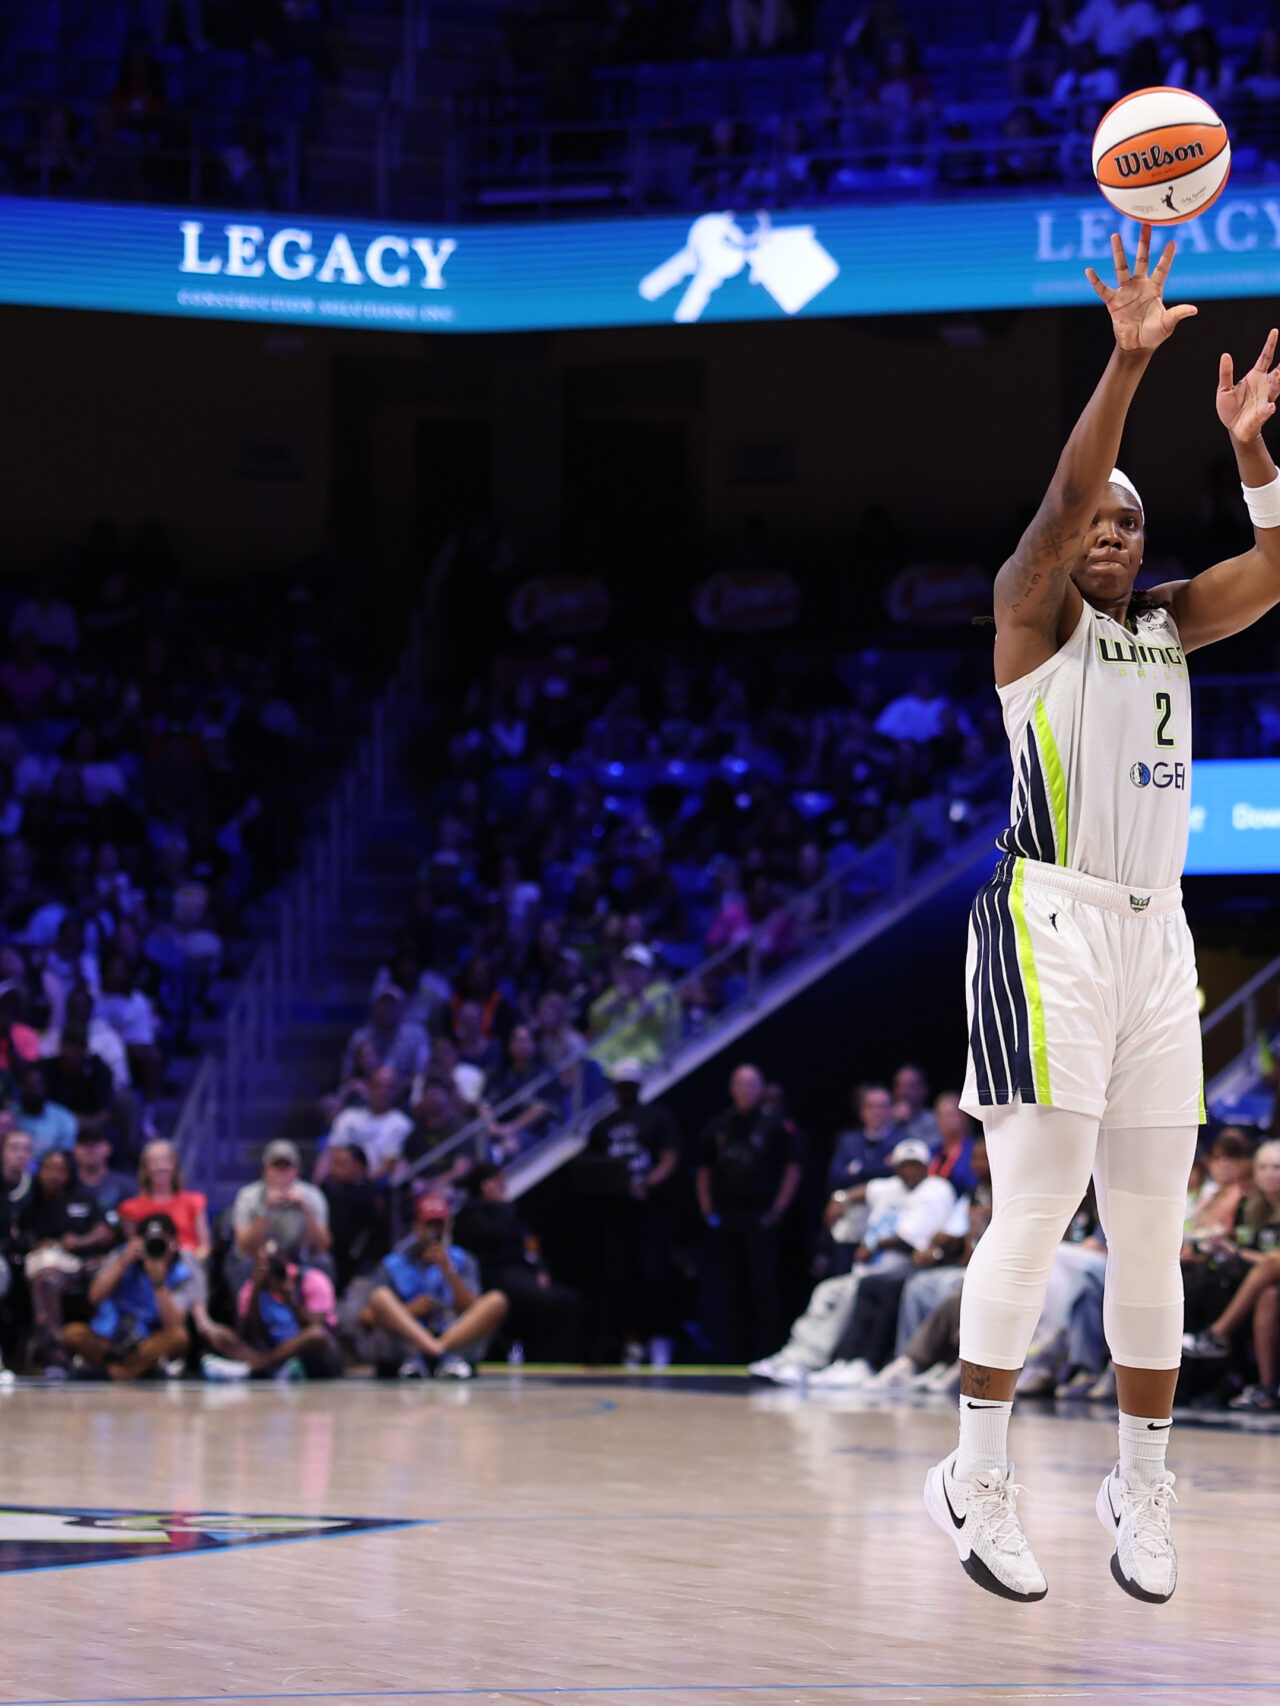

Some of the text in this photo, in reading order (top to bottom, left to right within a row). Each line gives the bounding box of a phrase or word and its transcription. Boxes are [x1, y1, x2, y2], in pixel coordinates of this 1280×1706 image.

[1113, 141, 1205, 178] Wilson
[178, 221, 458, 289] LEGACY
[1097, 637, 1184, 667] WING
[1154, 690, 1177, 748] 2
